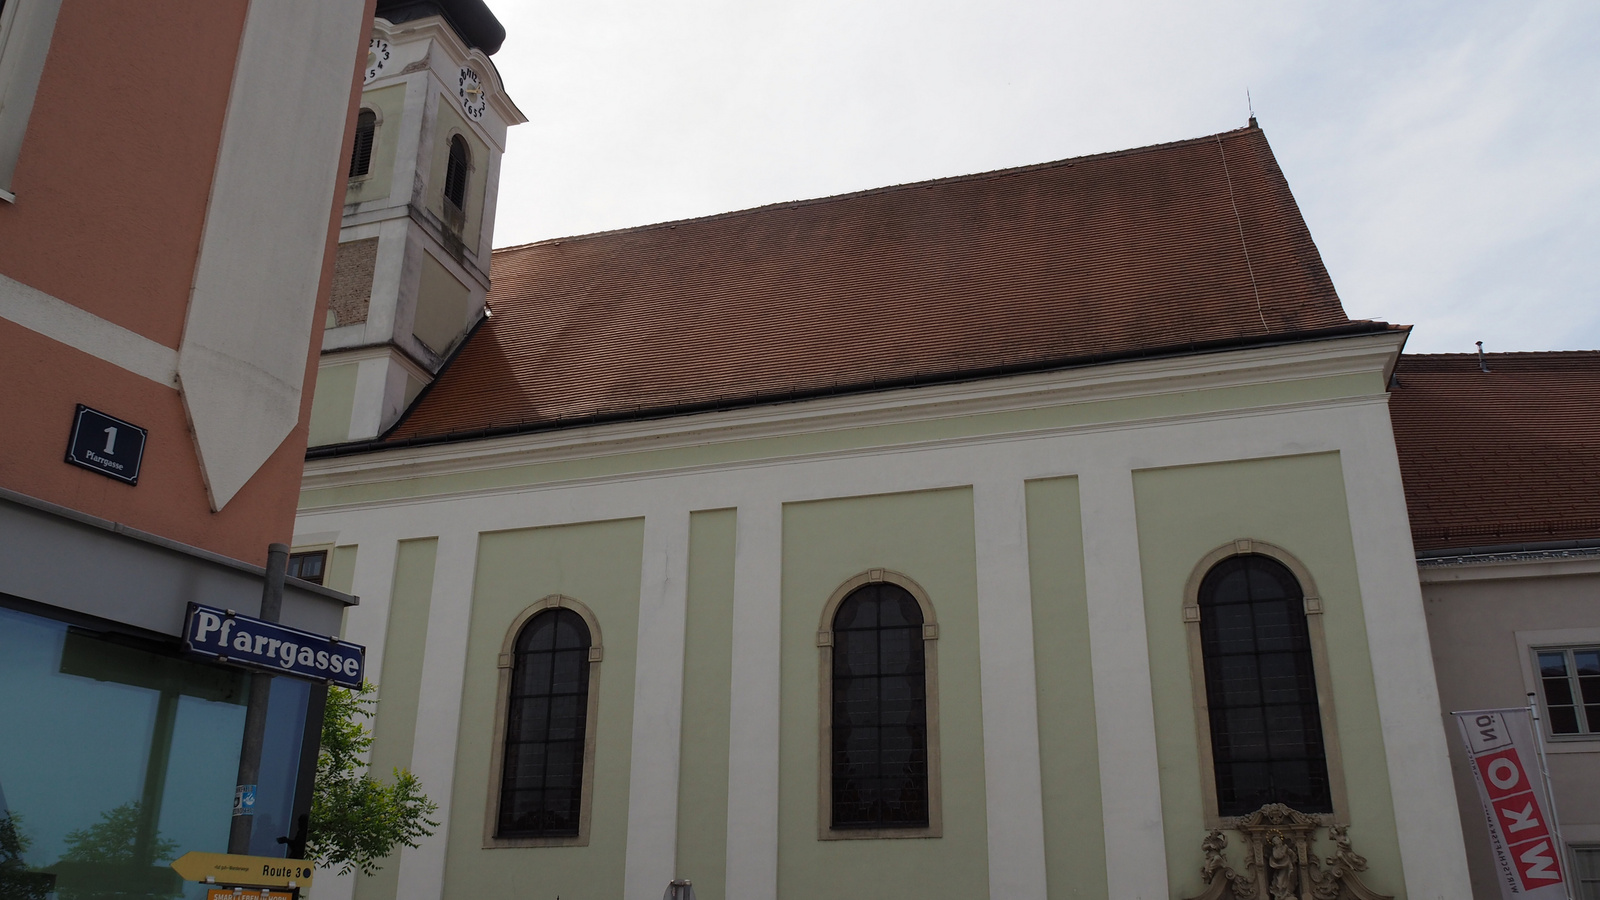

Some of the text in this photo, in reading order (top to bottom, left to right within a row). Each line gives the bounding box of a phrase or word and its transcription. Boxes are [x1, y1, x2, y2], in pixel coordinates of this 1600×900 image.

[382, 43, 387, 52] 2
[384, 51, 389, 60] 3
[370, 69, 375, 78] 5
[468, 105, 472, 114] 6
[104, 426, 118, 455] 1
[85, 449, 124, 471] Pfarrgasse
[194, 611, 359, 677] Pfarrgasse
[262, 864, 292, 878] Route
[295, 867, 302, 878] 3
